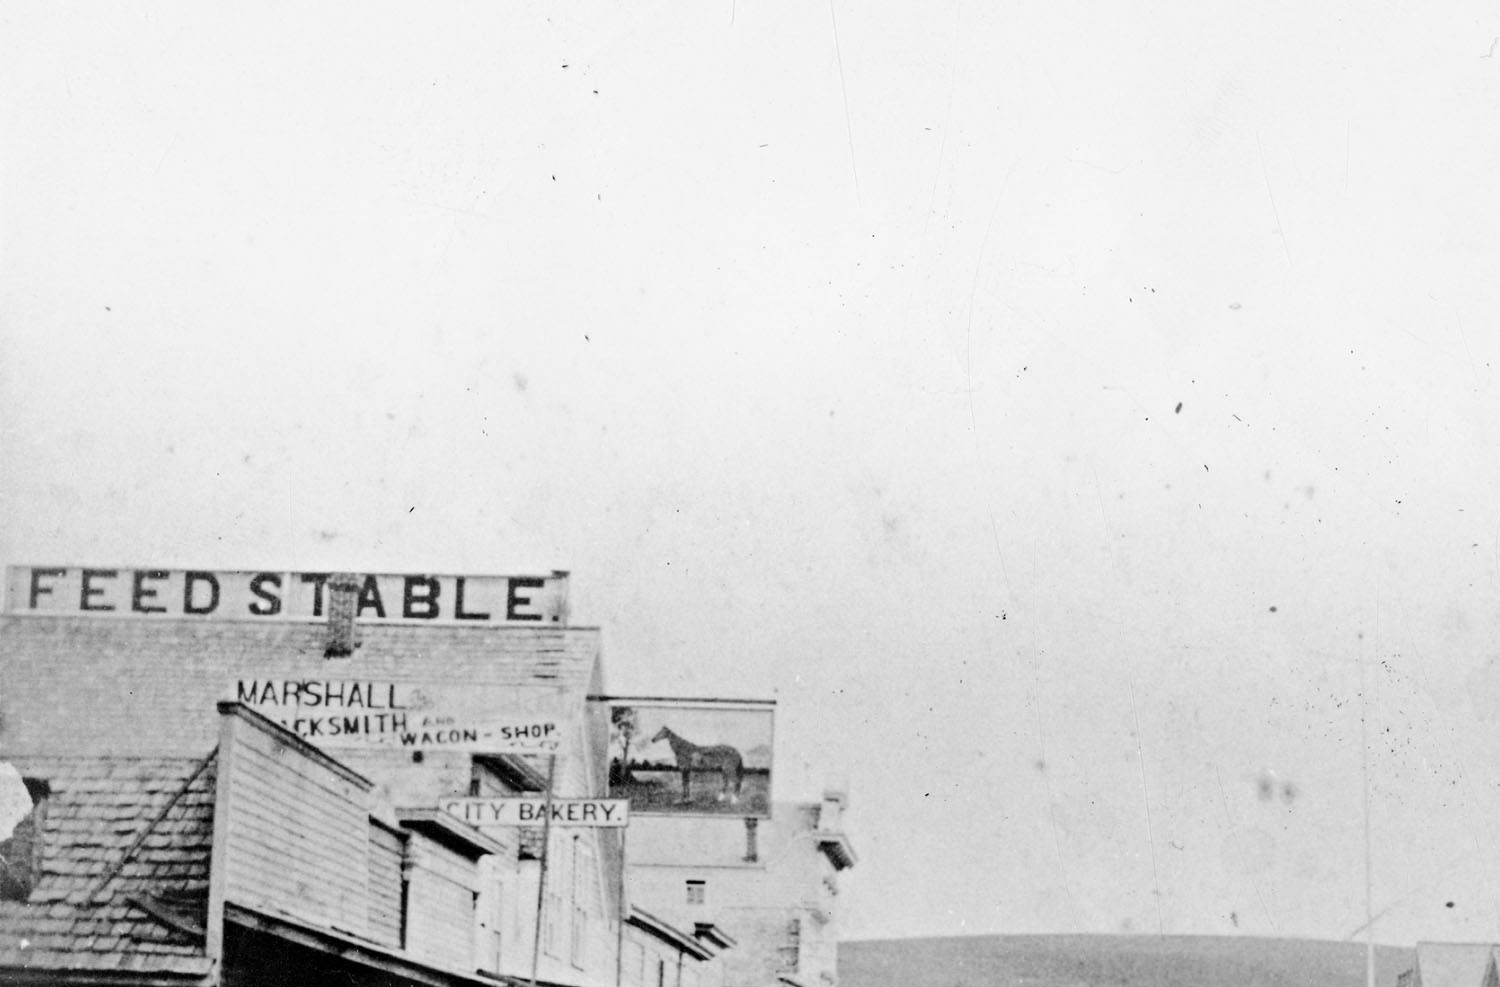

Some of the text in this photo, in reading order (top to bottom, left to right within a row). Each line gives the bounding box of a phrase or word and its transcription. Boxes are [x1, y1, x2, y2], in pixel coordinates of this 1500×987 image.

[28, 567, 560, 623] FEED STABLE.
[237, 680, 408, 710] MARSHALL
[282, 713, 408, 737] CKSMITH
[446, 802, 623, 822] CITY BAKERY.
